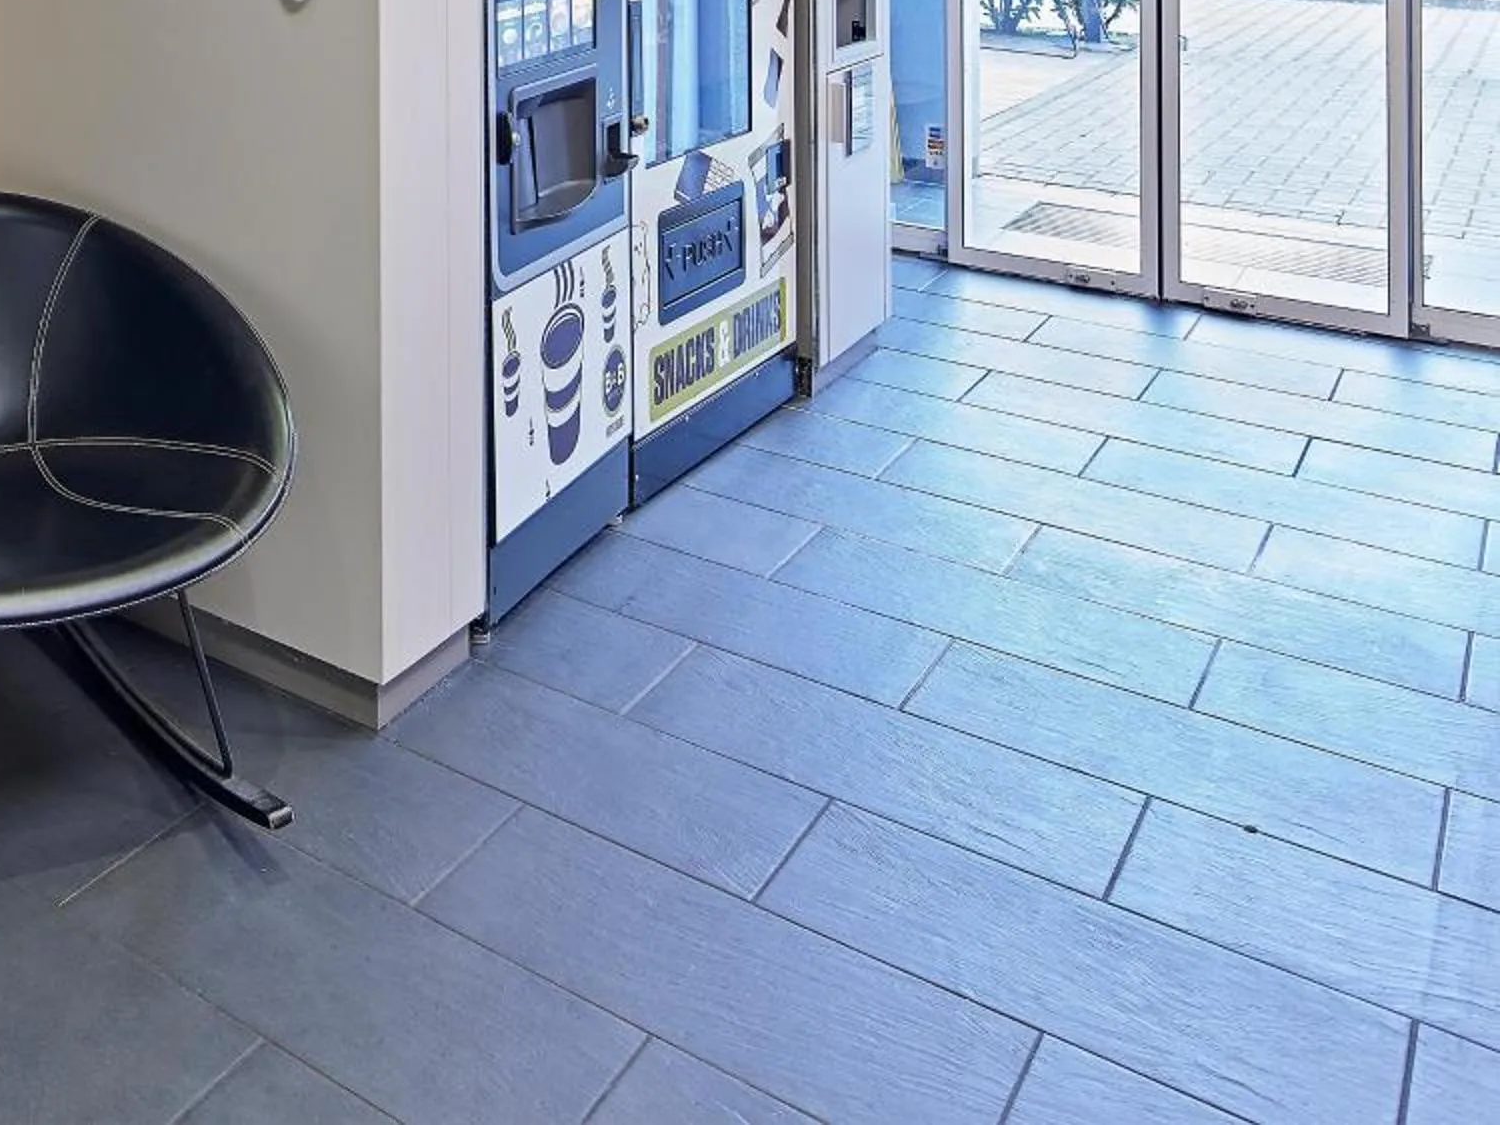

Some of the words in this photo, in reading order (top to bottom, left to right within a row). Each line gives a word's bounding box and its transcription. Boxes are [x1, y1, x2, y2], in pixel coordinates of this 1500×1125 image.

[683, 230, 723, 273] PUSH
[653, 326, 715, 406] SNACKS
[718, 319, 732, 368] &
[733, 290, 781, 360] DRINKS
